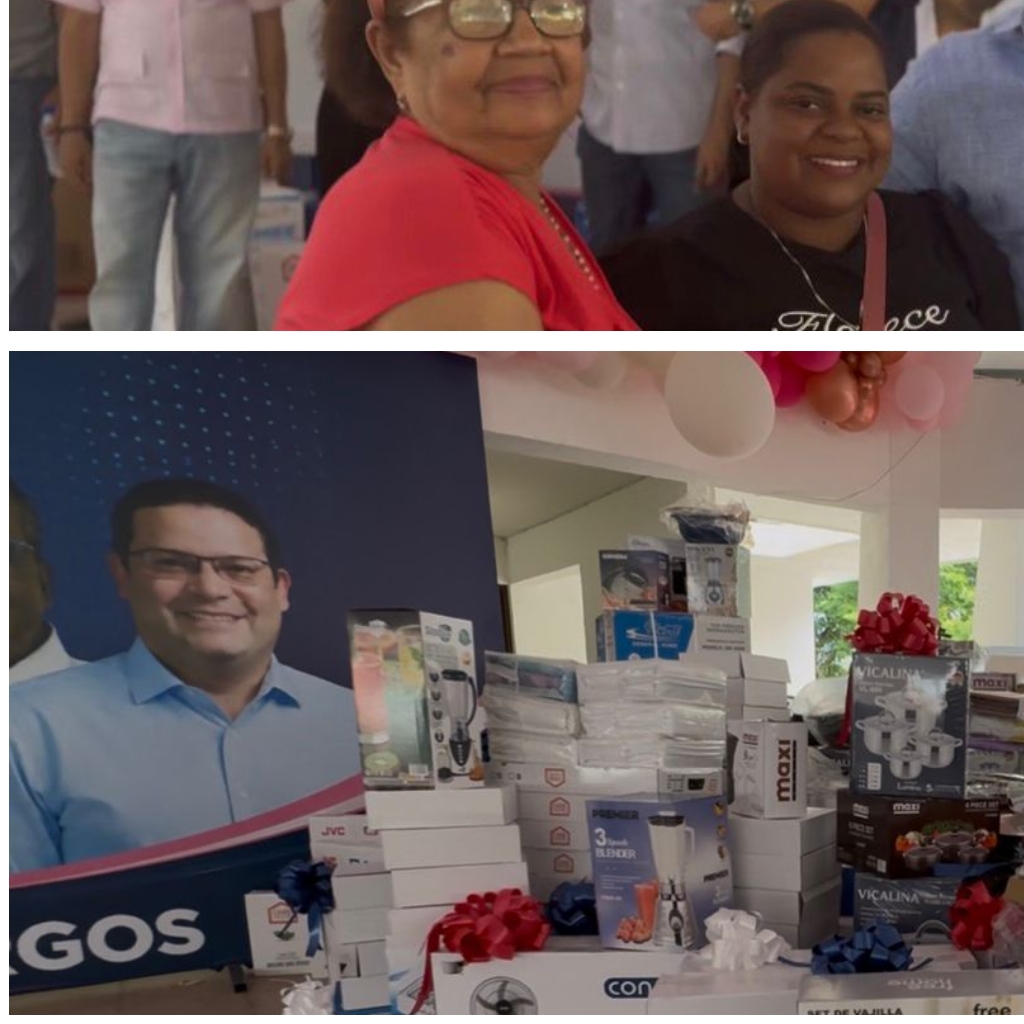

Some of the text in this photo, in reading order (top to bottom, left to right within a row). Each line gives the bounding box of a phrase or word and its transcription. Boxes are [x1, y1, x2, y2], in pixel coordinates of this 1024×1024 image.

[857, 666, 922, 679] VICALINA
[972, 677, 1008, 689] maxi
[776, 739, 791, 802] maxi
[893, 802, 921, 811] maxi
[321, 826, 345, 836] JVC
[594, 828, 607, 847] 3
[595, 847, 638, 859] BLENDER
[858, 889, 920, 904] VICALINA
[608, 980, 650, 996] con
[972, 1002, 1012, 1014] free
